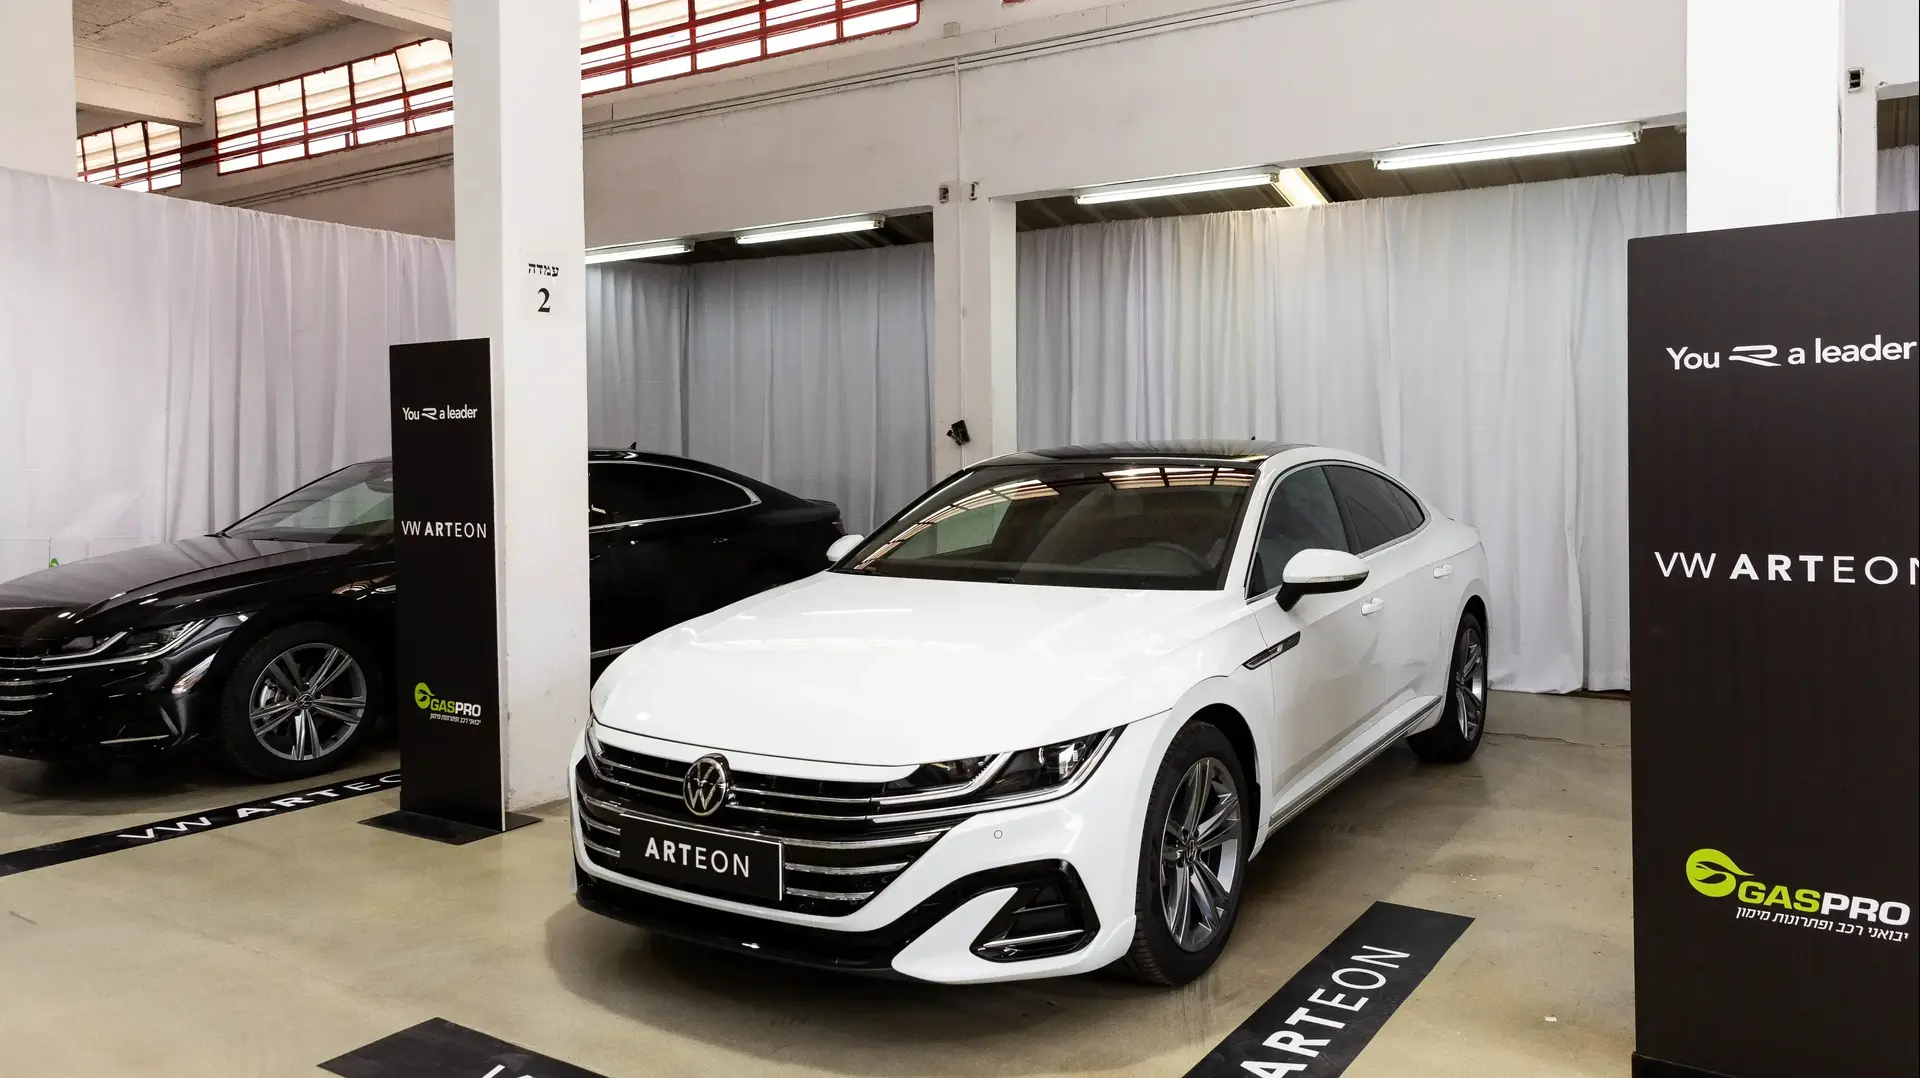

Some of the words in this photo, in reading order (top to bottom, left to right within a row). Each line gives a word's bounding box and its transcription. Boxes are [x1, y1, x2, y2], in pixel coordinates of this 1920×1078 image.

[528, 262, 560, 277] עמדה
[537, 287, 551, 313] 2
[1666, 346, 1720, 370] You
[1787, 347, 1806, 365] a
[1815, 334, 1918, 364] leader
[402, 407, 420, 421] You
[439, 409, 446, 420] a
[447, 404, 478, 420] leader
[401, 520, 421, 536] VW
[424, 521, 487, 539] ARTEON
[1654, 551, 1717, 579] VW
[430, 698, 482, 717] GASPRO
[116, 816, 212, 840] VW
[644, 837, 749, 878] ARTEON
[1737, 880, 1911, 926] GASPRO
[1736, 906, 1772, 922] מימון
[1772, 912, 1834, 931] ופתרונות
[1835, 922, 1864, 936] רכב
[1868, 926, 1910, 942] יבואני
[1239, 945, 1411, 1078] ARTEON
